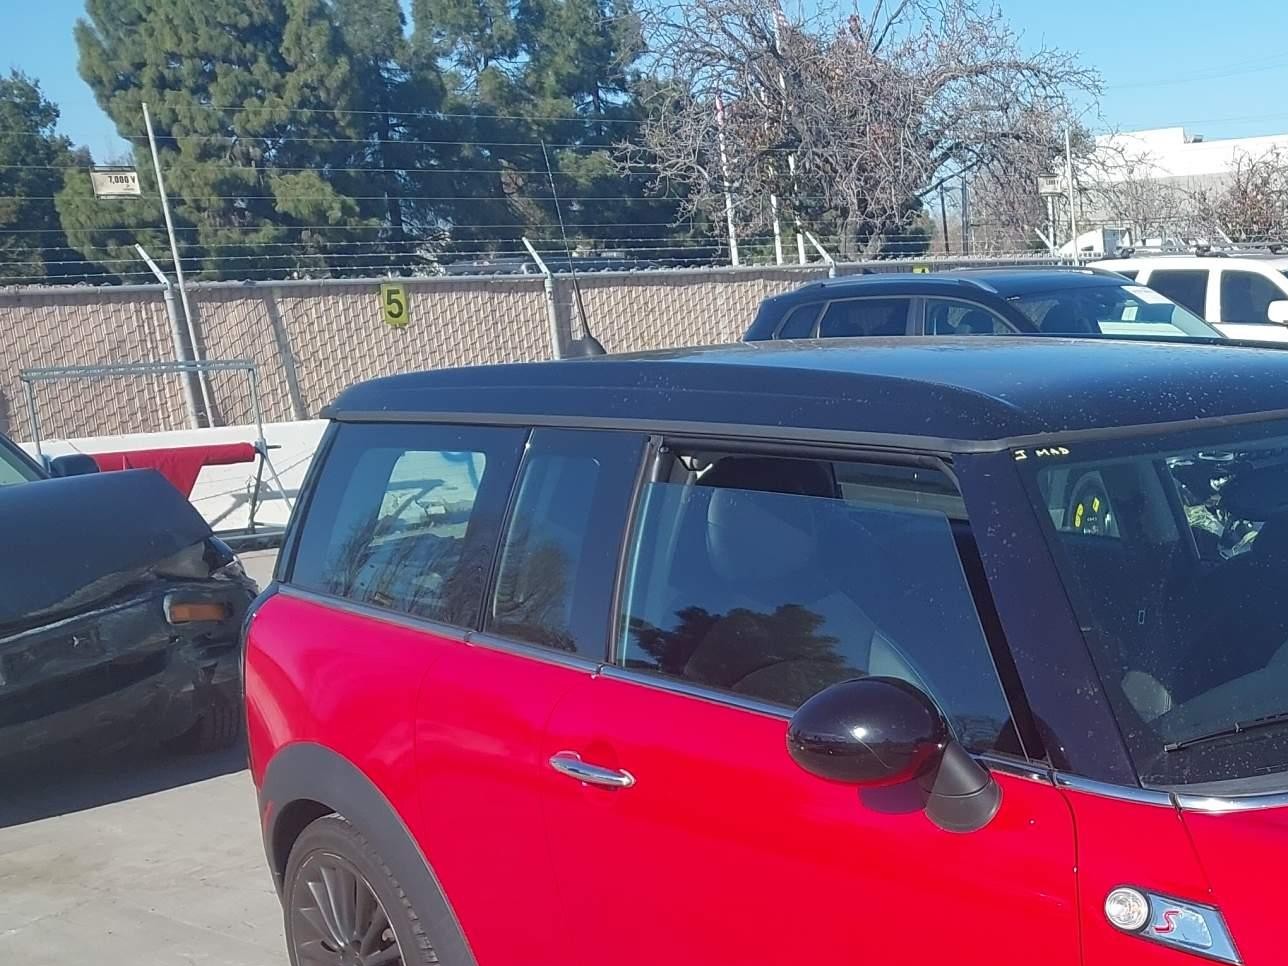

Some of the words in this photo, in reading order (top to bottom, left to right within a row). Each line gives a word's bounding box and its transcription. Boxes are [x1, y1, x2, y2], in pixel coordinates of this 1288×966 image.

[107, 175, 129, 184] 7,000
[386, 289, 404, 319] 5
[1152, 908, 1183, 935] S
